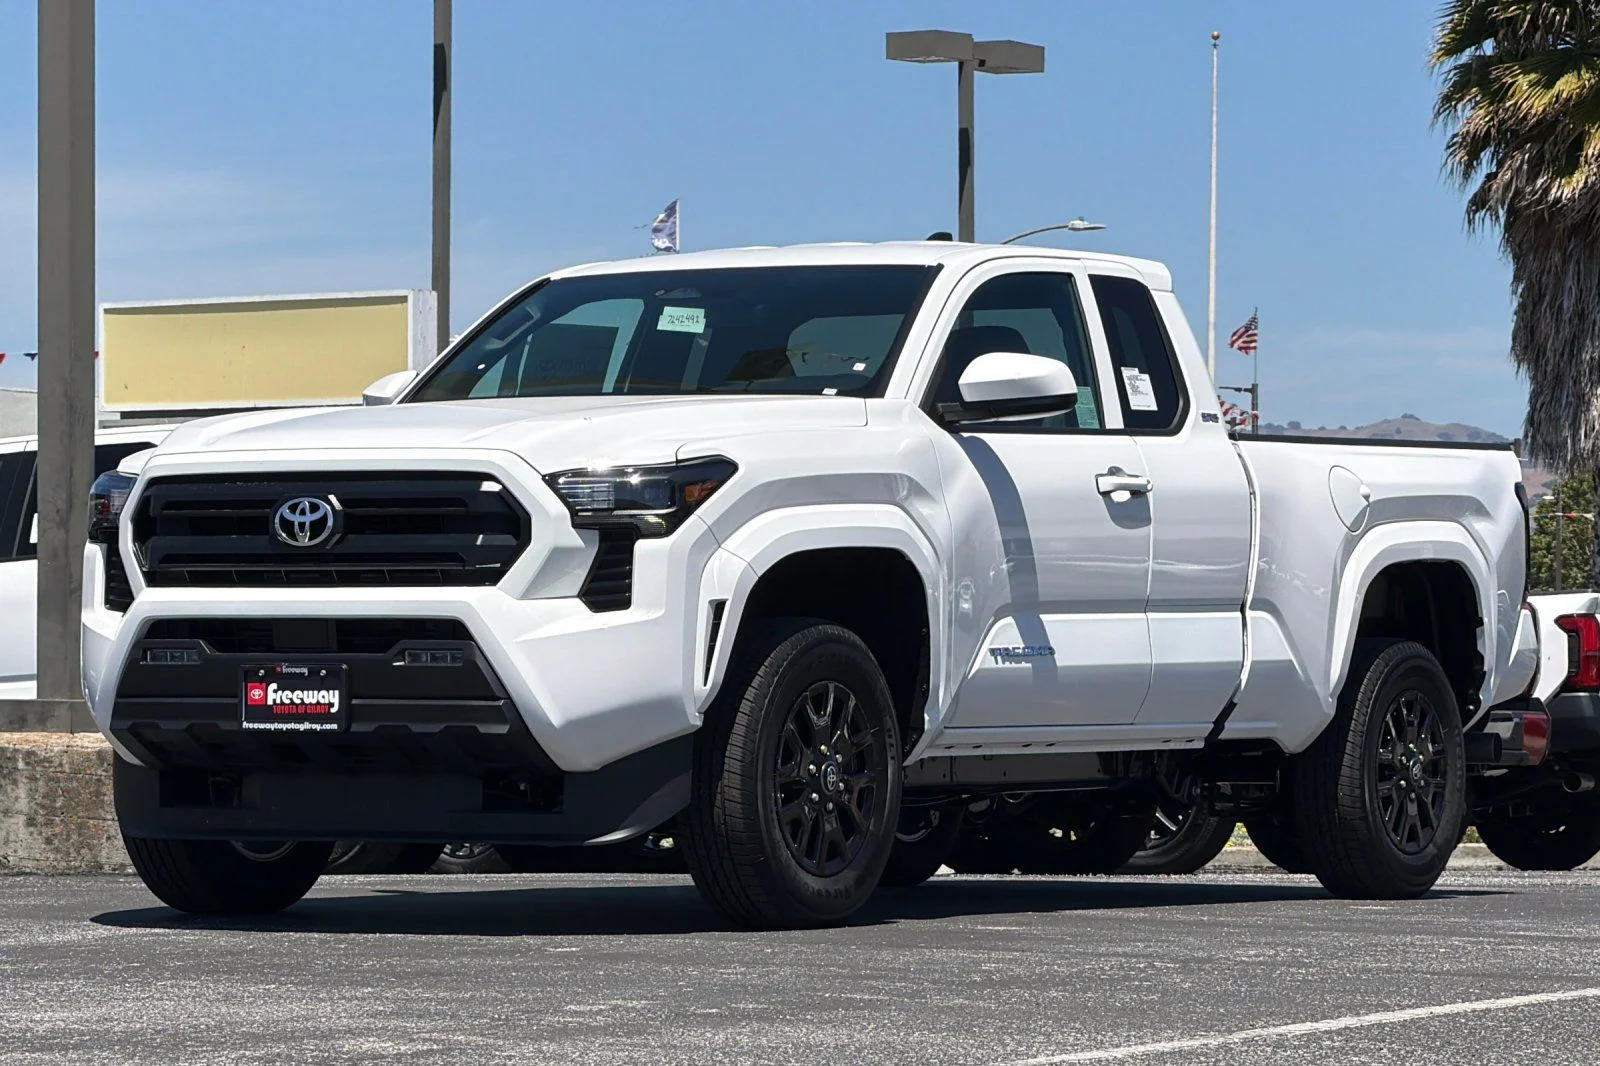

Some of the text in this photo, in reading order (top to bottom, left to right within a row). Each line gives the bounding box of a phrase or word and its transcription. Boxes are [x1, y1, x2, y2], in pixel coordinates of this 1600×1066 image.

[273, 705, 329, 713] TOYOTA OF GILROY
[242, 721, 338, 731] freewaytoyotagilroy.com
